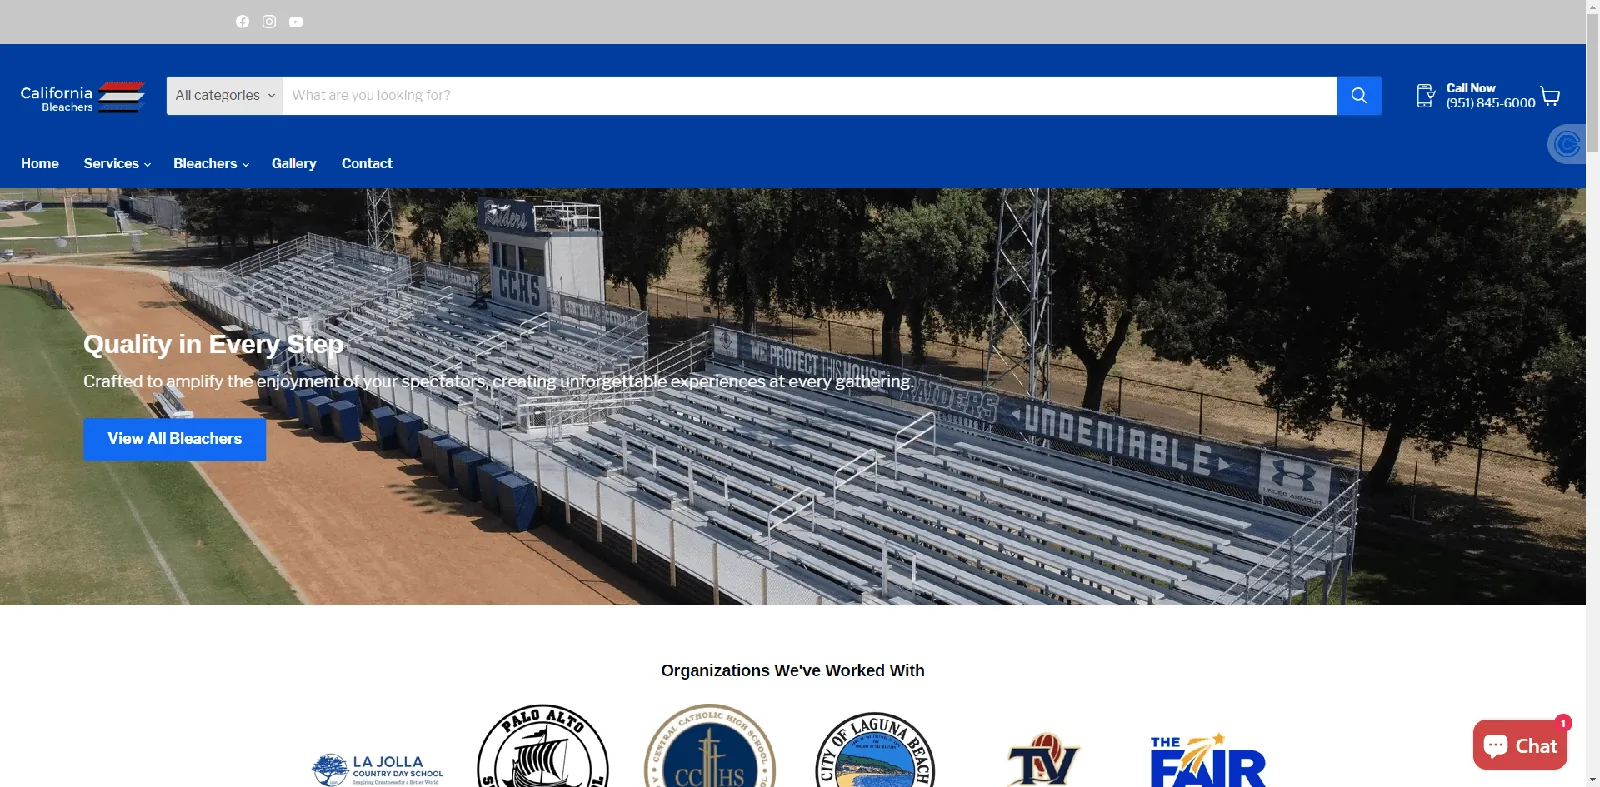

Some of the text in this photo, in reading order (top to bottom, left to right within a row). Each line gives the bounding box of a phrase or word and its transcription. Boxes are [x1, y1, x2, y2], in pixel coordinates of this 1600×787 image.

[20, 86, 94, 100] California
[1446, 82, 1497, 93] Call Now
[175, 89, 260, 103] All categories
[292, 89, 451, 103] What are you looking for?
[1446, 97, 1536, 110] (951) 845-6000
[41, 102, 94, 112] Bleachers
[21, 157, 60, 170] Home
[83, 157, 140, 170] Services
[173, 157, 238, 170] Bleachers
[271, 157, 317, 172] Gallery
[341, 157, 394, 170] Contact
[484, 200, 528, 230] Raiders
[499, 269, 540, 307] CCHS
[83, 334, 345, 359] Quality in Every Step
[770, 344, 819, 376] PROTECT
[83, 374, 915, 391] Crafted to amplify the enjoyment of your spectators, creating unforgettable experiences at every gathering.
[899, 372, 1000, 424] RAIDERS
[107, 431, 243, 445] View All Bleachers
[1024, 403, 1213, 477] UNDENIABLE
[661, 663, 925, 680] Organizations We've Worked With
[501, 709, 585, 734] PALO ALTO
[1561, 719, 1566, 728] 1
[653, 711, 769, 765] CENTRAL CATHOLIC HIGH SCHOOL
[1151, 737, 1180, 747] THE
[1516, 737, 1558, 754] Chat
[821, 749, 836, 781] CITY
[831, 729, 849, 747] OF
[850, 717, 908, 740] LAGUNA
[907, 736, 930, 785] BEACH
[353, 755, 424, 768] LA JOLLA
[1007, 747, 1081, 785] TV
[1151, 749, 1267, 787] FAIR
